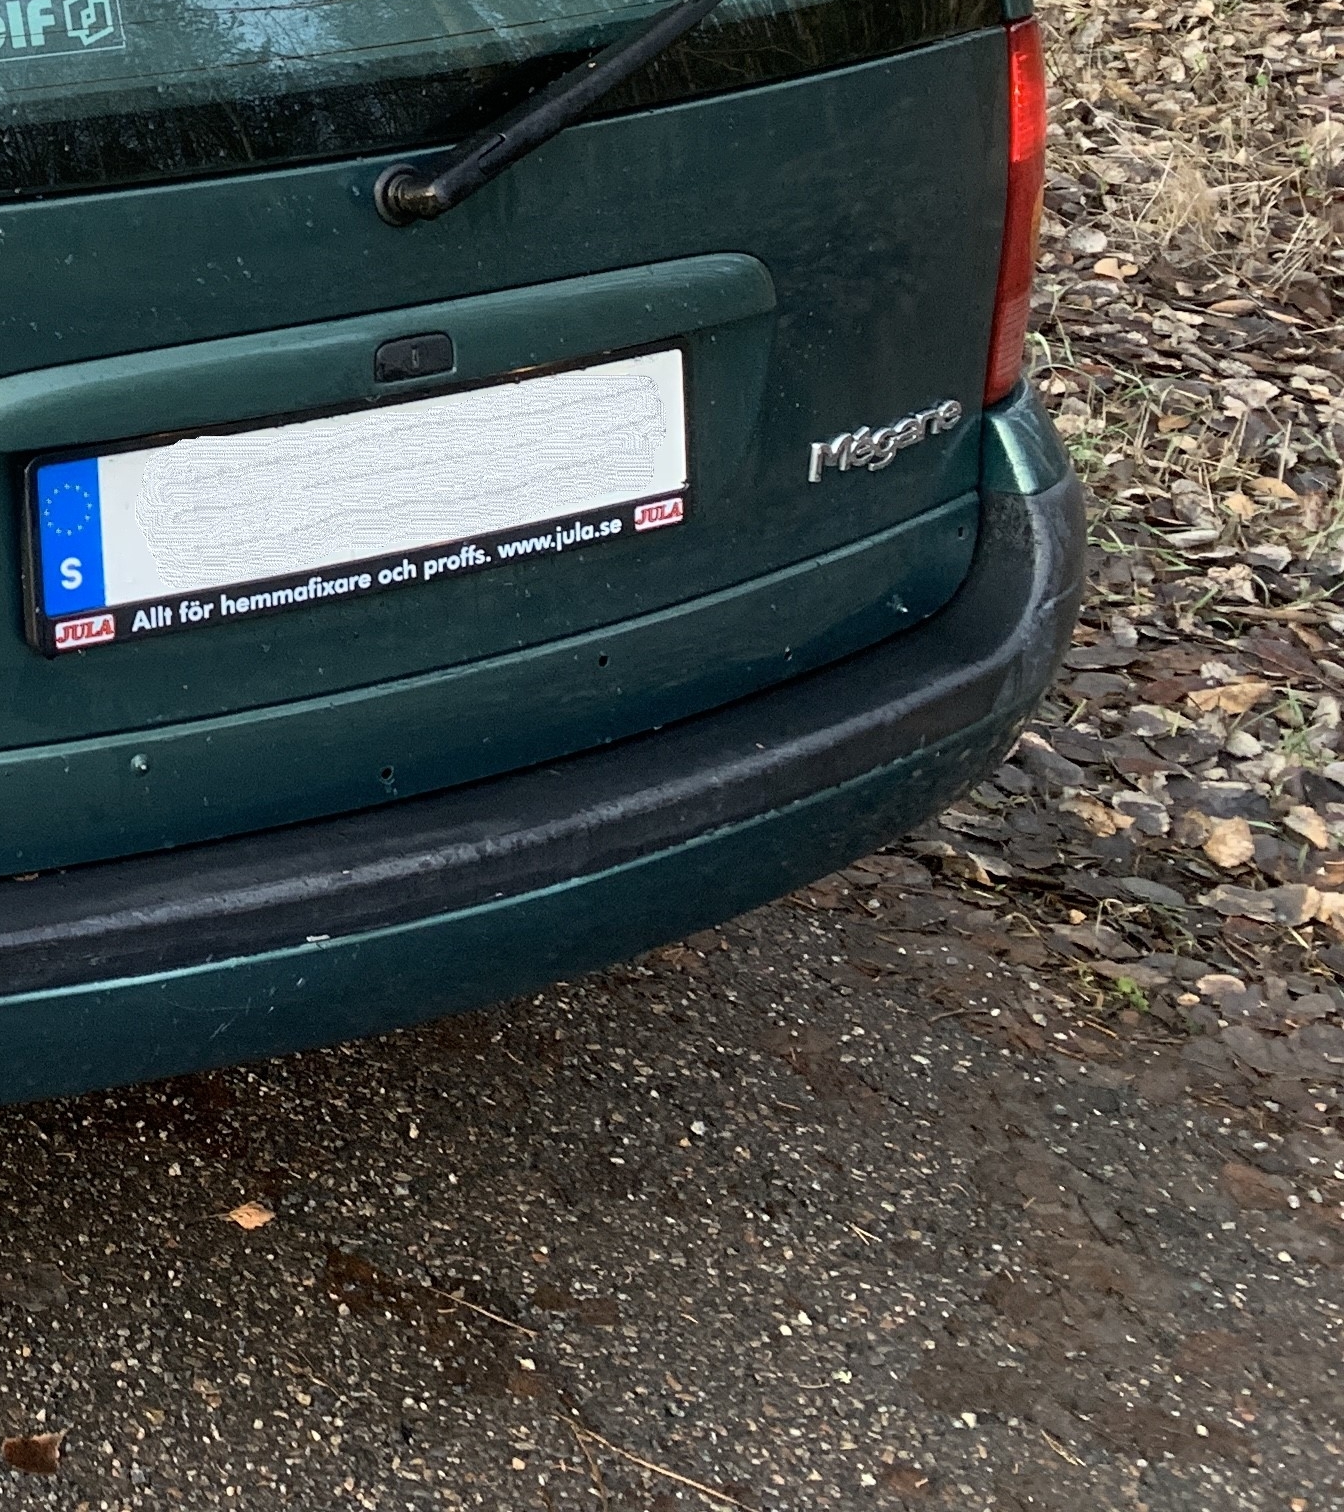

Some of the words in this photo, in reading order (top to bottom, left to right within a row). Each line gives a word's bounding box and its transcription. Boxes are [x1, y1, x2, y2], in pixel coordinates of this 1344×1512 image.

[808, 399, 962, 483] Mégane
[634, 500, 683, 525] JULA
[60, 557, 83, 590] S
[131, 605, 173, 633] Allt
[179, 599, 214, 623] för
[220, 572, 372, 617] hemmafixare
[377, 558, 417, 585] och
[423, 543, 492, 580] proffs.
[497, 517, 623, 559] www.jula.se
[56, 618, 115, 644] JULA
